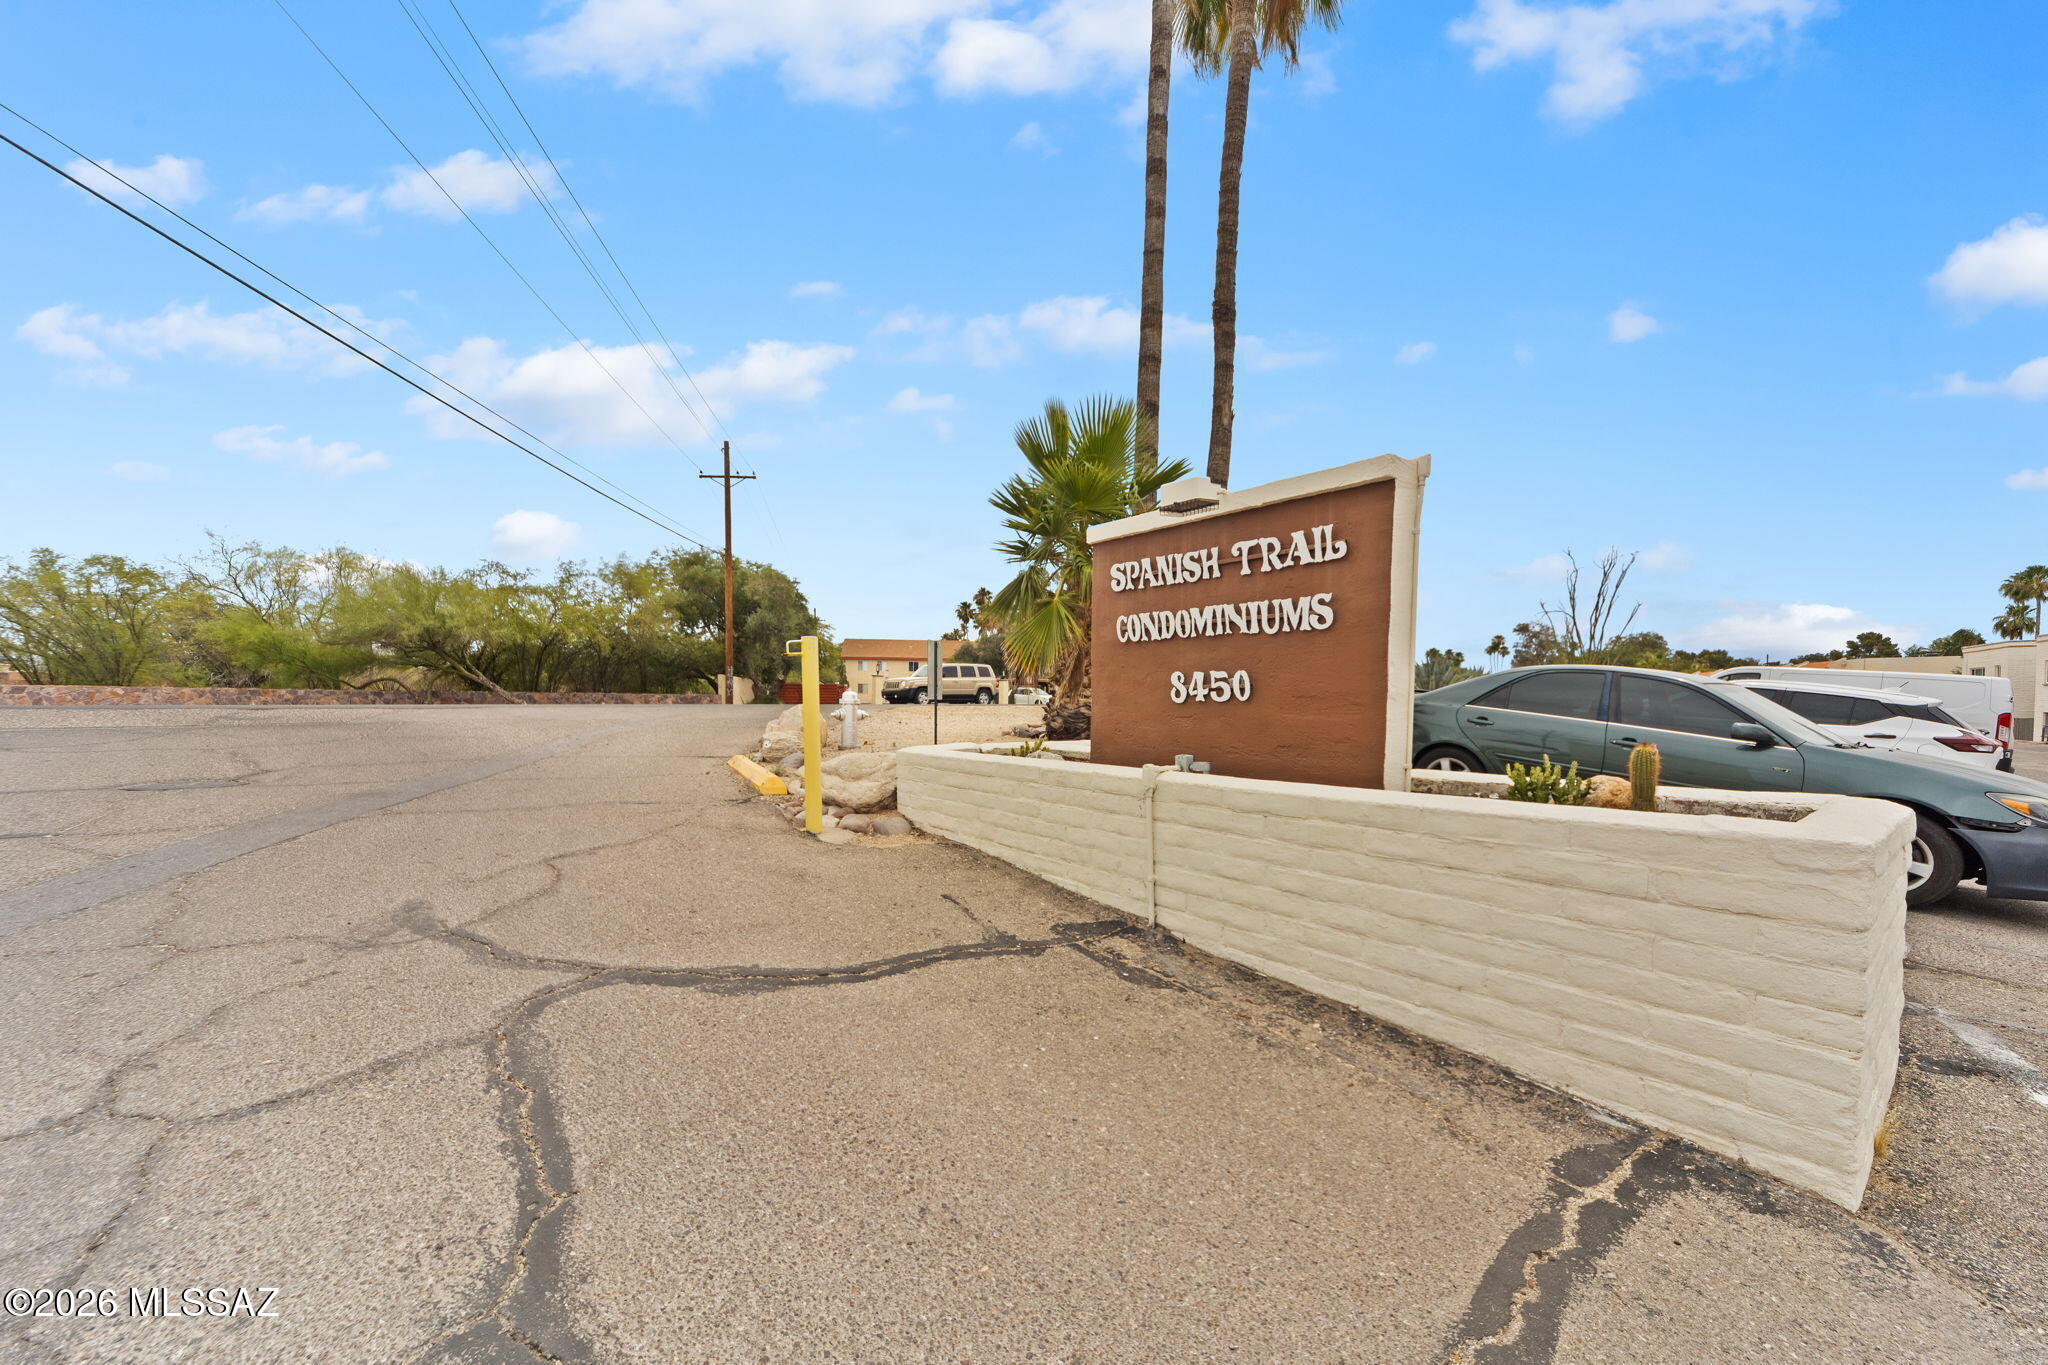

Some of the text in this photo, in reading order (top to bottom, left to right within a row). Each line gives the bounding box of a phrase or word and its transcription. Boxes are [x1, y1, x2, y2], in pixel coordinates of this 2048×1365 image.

[1110, 524, 1347, 592] SPANISH TRAIL
[1116, 593, 1334, 643] CONDOMINIUMS
[1170, 670, 1250, 703] 8450
